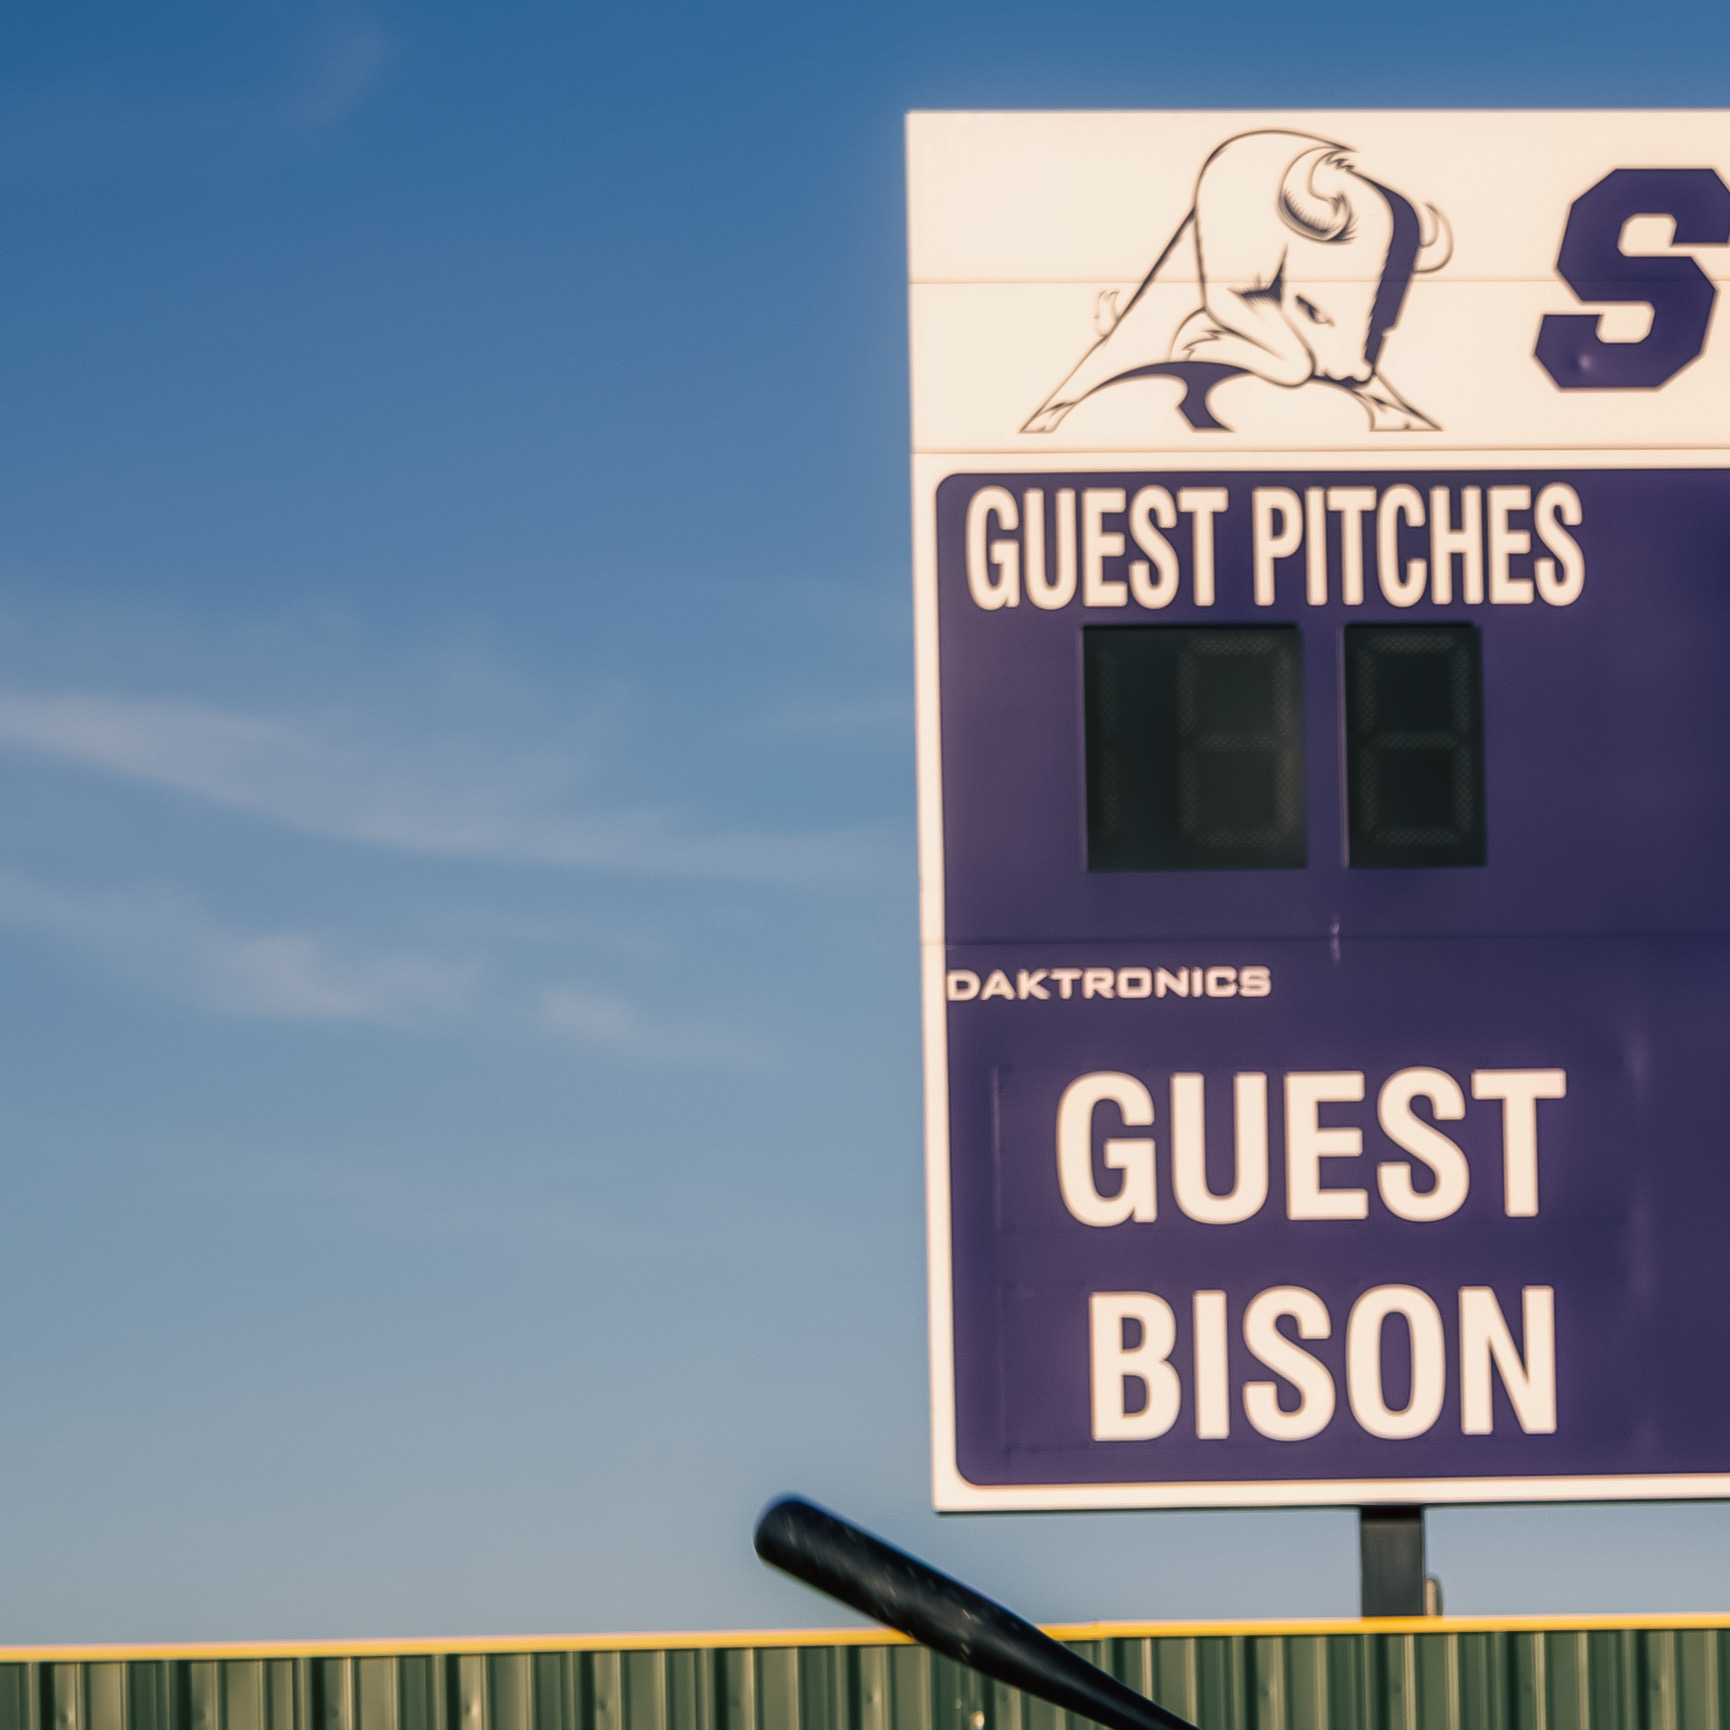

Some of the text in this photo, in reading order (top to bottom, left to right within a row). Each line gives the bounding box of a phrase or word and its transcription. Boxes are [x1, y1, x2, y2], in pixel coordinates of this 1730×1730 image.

[964, 481, 1586, 612] GUEST PITCHES
[947, 965, 1272, 1001] DAKTRONICS
[1055, 1066, 1567, 1228] GUEST
[1088, 1284, 1558, 1442] BISON
